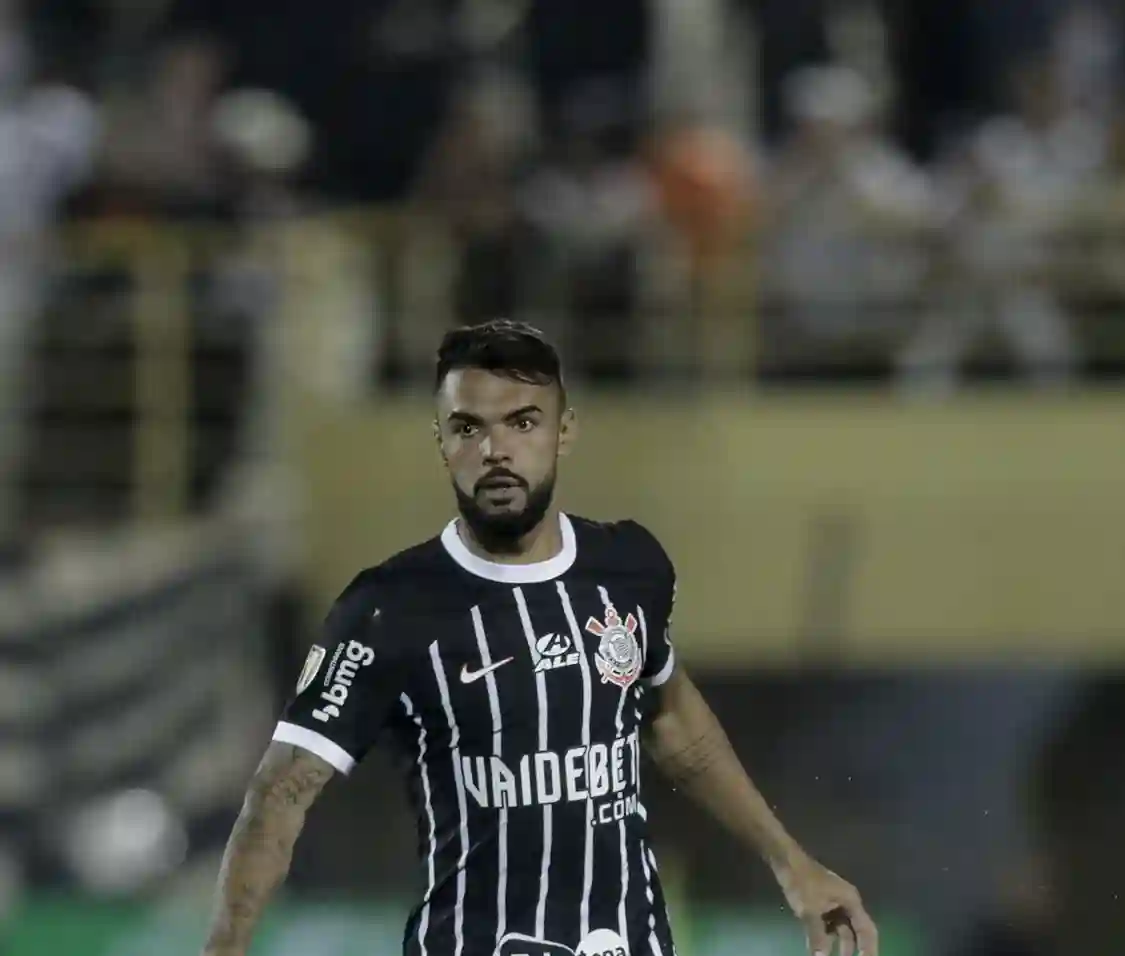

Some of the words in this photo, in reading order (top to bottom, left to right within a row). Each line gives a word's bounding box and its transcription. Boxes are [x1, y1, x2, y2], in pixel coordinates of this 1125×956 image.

[321, 639, 375, 706] bmg
[534, 652, 580, 673] ALE
[461, 732, 637, 809] VAIDEBET
